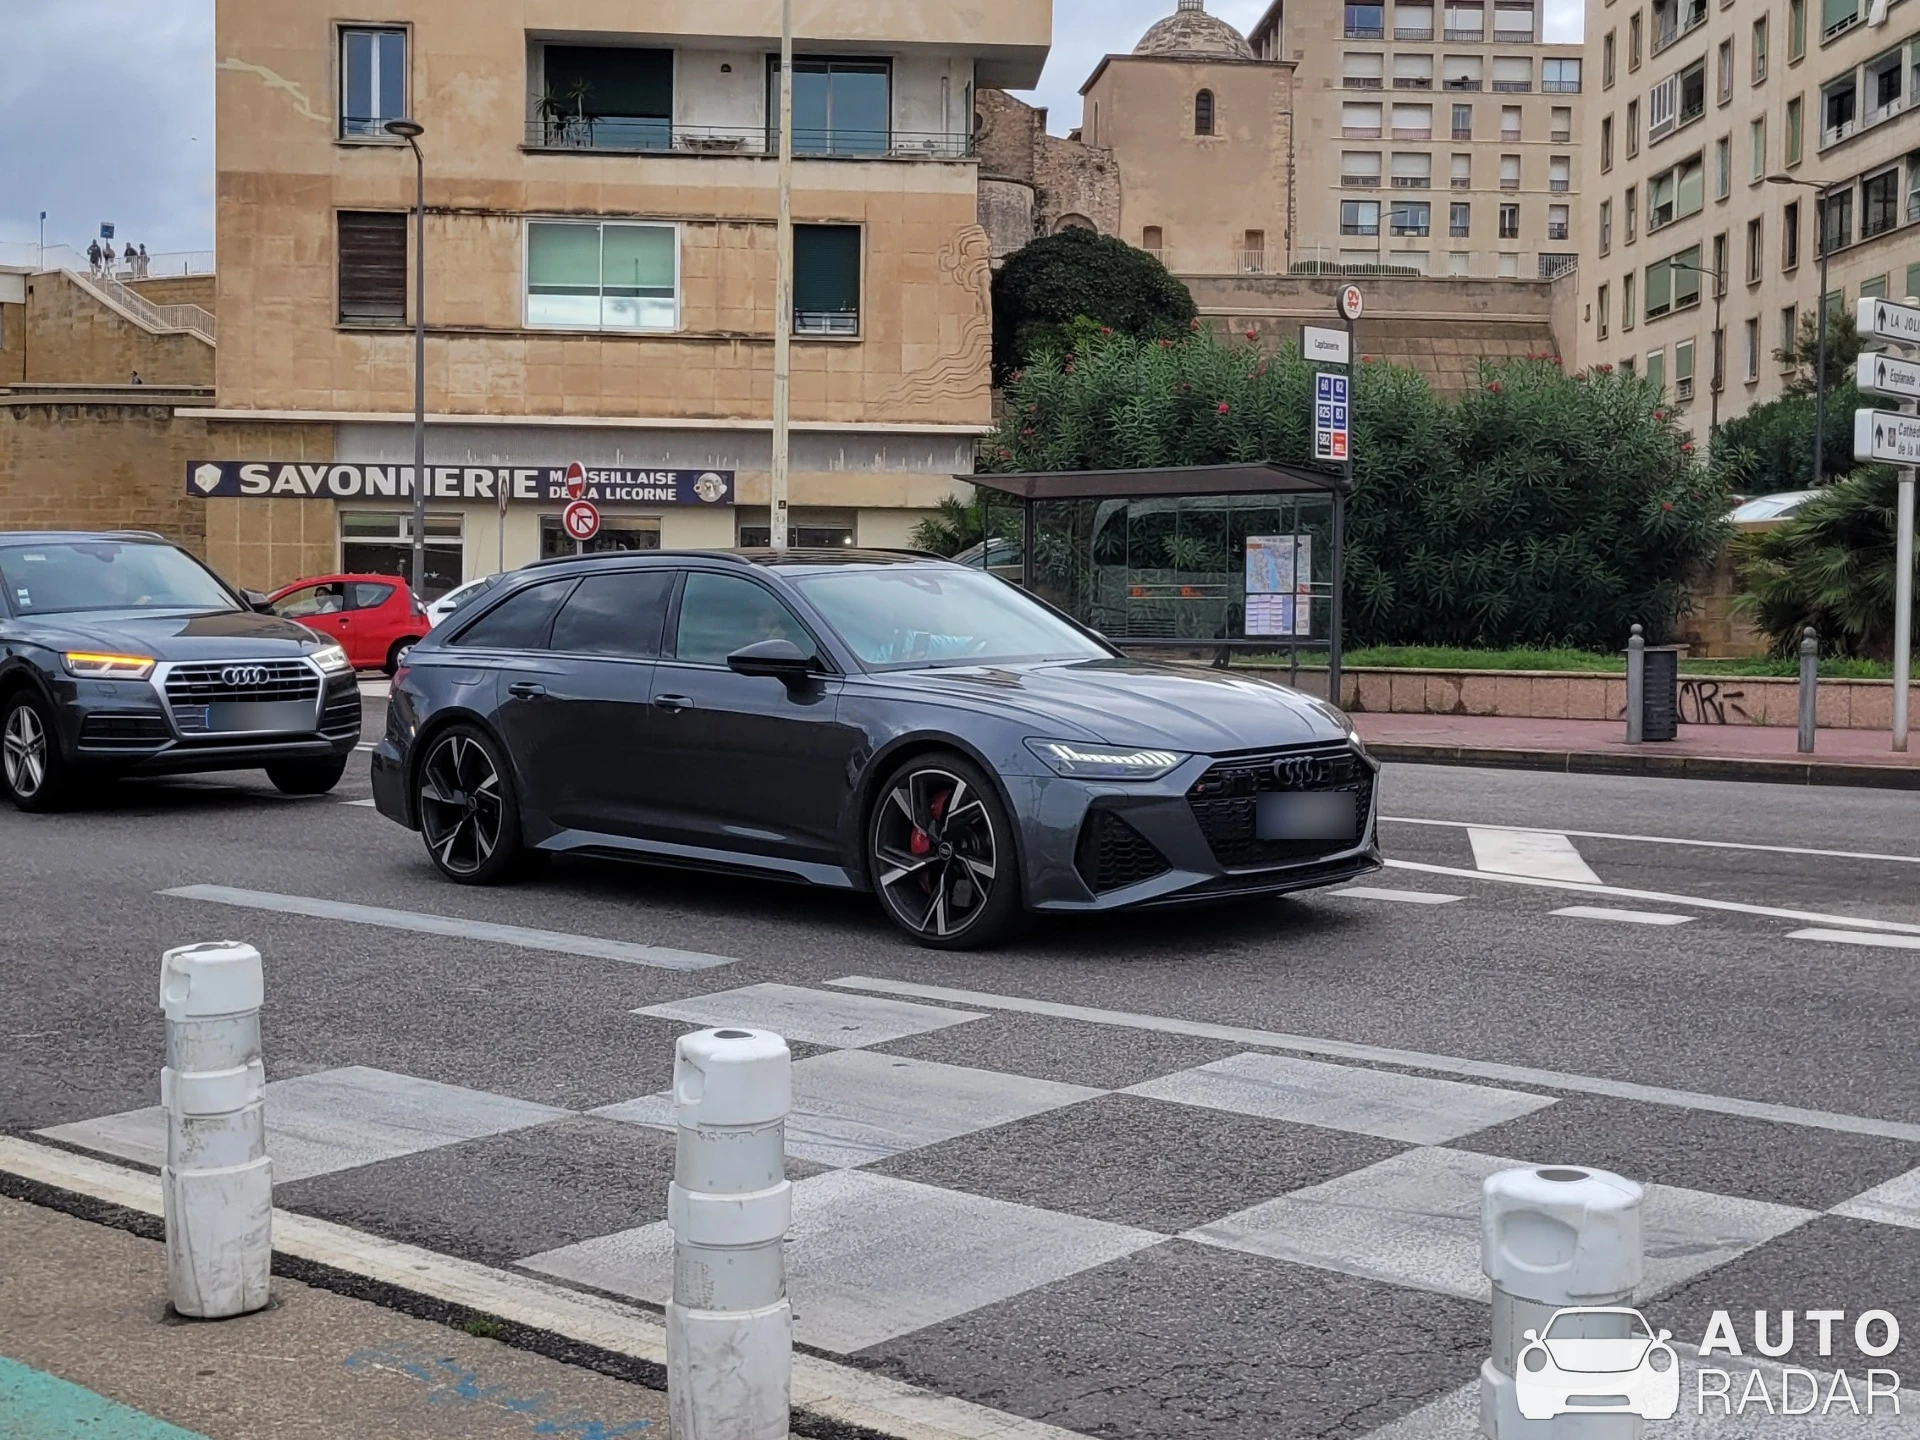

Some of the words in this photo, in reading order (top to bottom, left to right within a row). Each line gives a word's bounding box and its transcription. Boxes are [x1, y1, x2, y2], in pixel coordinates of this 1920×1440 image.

[1890, 313, 1900, 329] LA
[1890, 368, 1916, 386] Esplanade
[1321, 379, 1329, 391] 60
[239, 464, 539, 498] SAVONNERIE
[549, 470, 677, 485] MSEILLAISE
[605, 488, 677, 501] LICORNE
